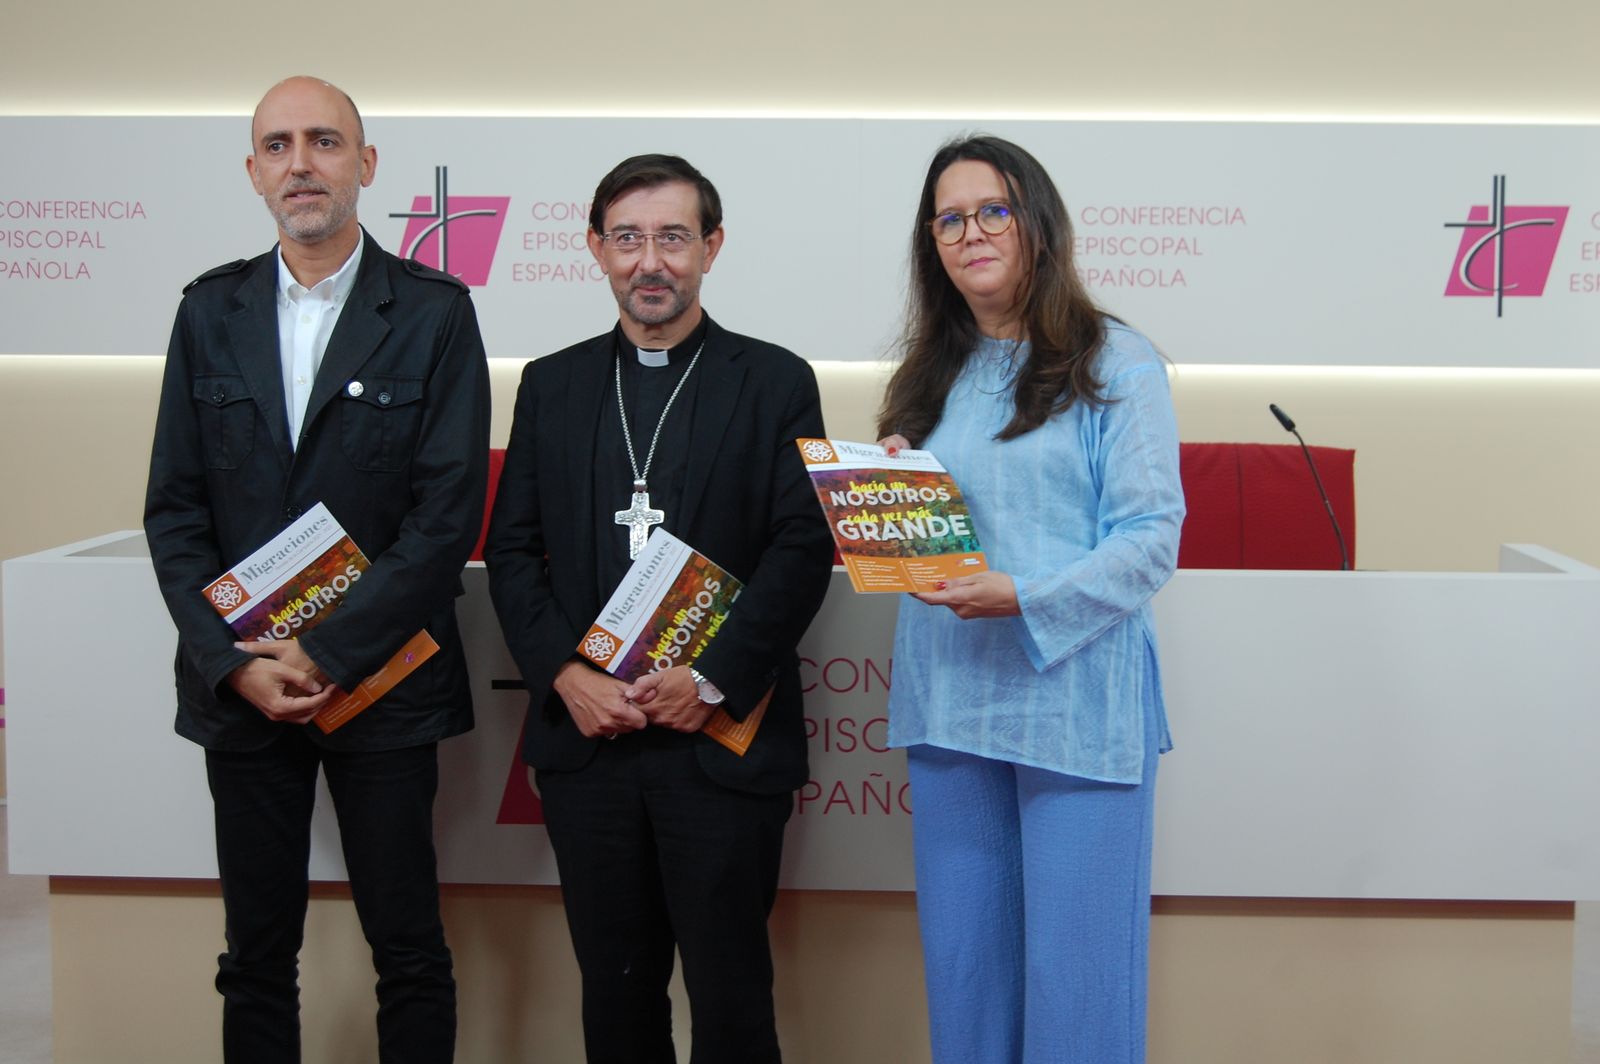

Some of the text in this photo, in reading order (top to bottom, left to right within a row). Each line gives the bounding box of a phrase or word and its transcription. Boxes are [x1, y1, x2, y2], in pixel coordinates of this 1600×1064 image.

[0, 200, 147, 219] ONFERENCIA
[1081, 206, 1247, 226] CONFERENCIA
[523, 232, 588, 251] EPISC
[0, 257, 91, 279] PAÑOLA
[512, 260, 607, 281] ESPAÑO
[1078, 264, 1187, 287] PAÑOLA
[829, 486, 951, 507] NOSOTROS
[849, 480, 907, 493] hacia un
[846, 506, 933, 523] cada vez más
[836, 514, 971, 542] GRANDE
[239, 516, 329, 585] Migraciones
[605, 540, 671, 630] Migraciones
[269, 585, 320, 625] hacia un
[646, 627, 676, 660] hacia
[673, 608, 688, 625] un
[648, 577, 721, 674] OSOTROS
